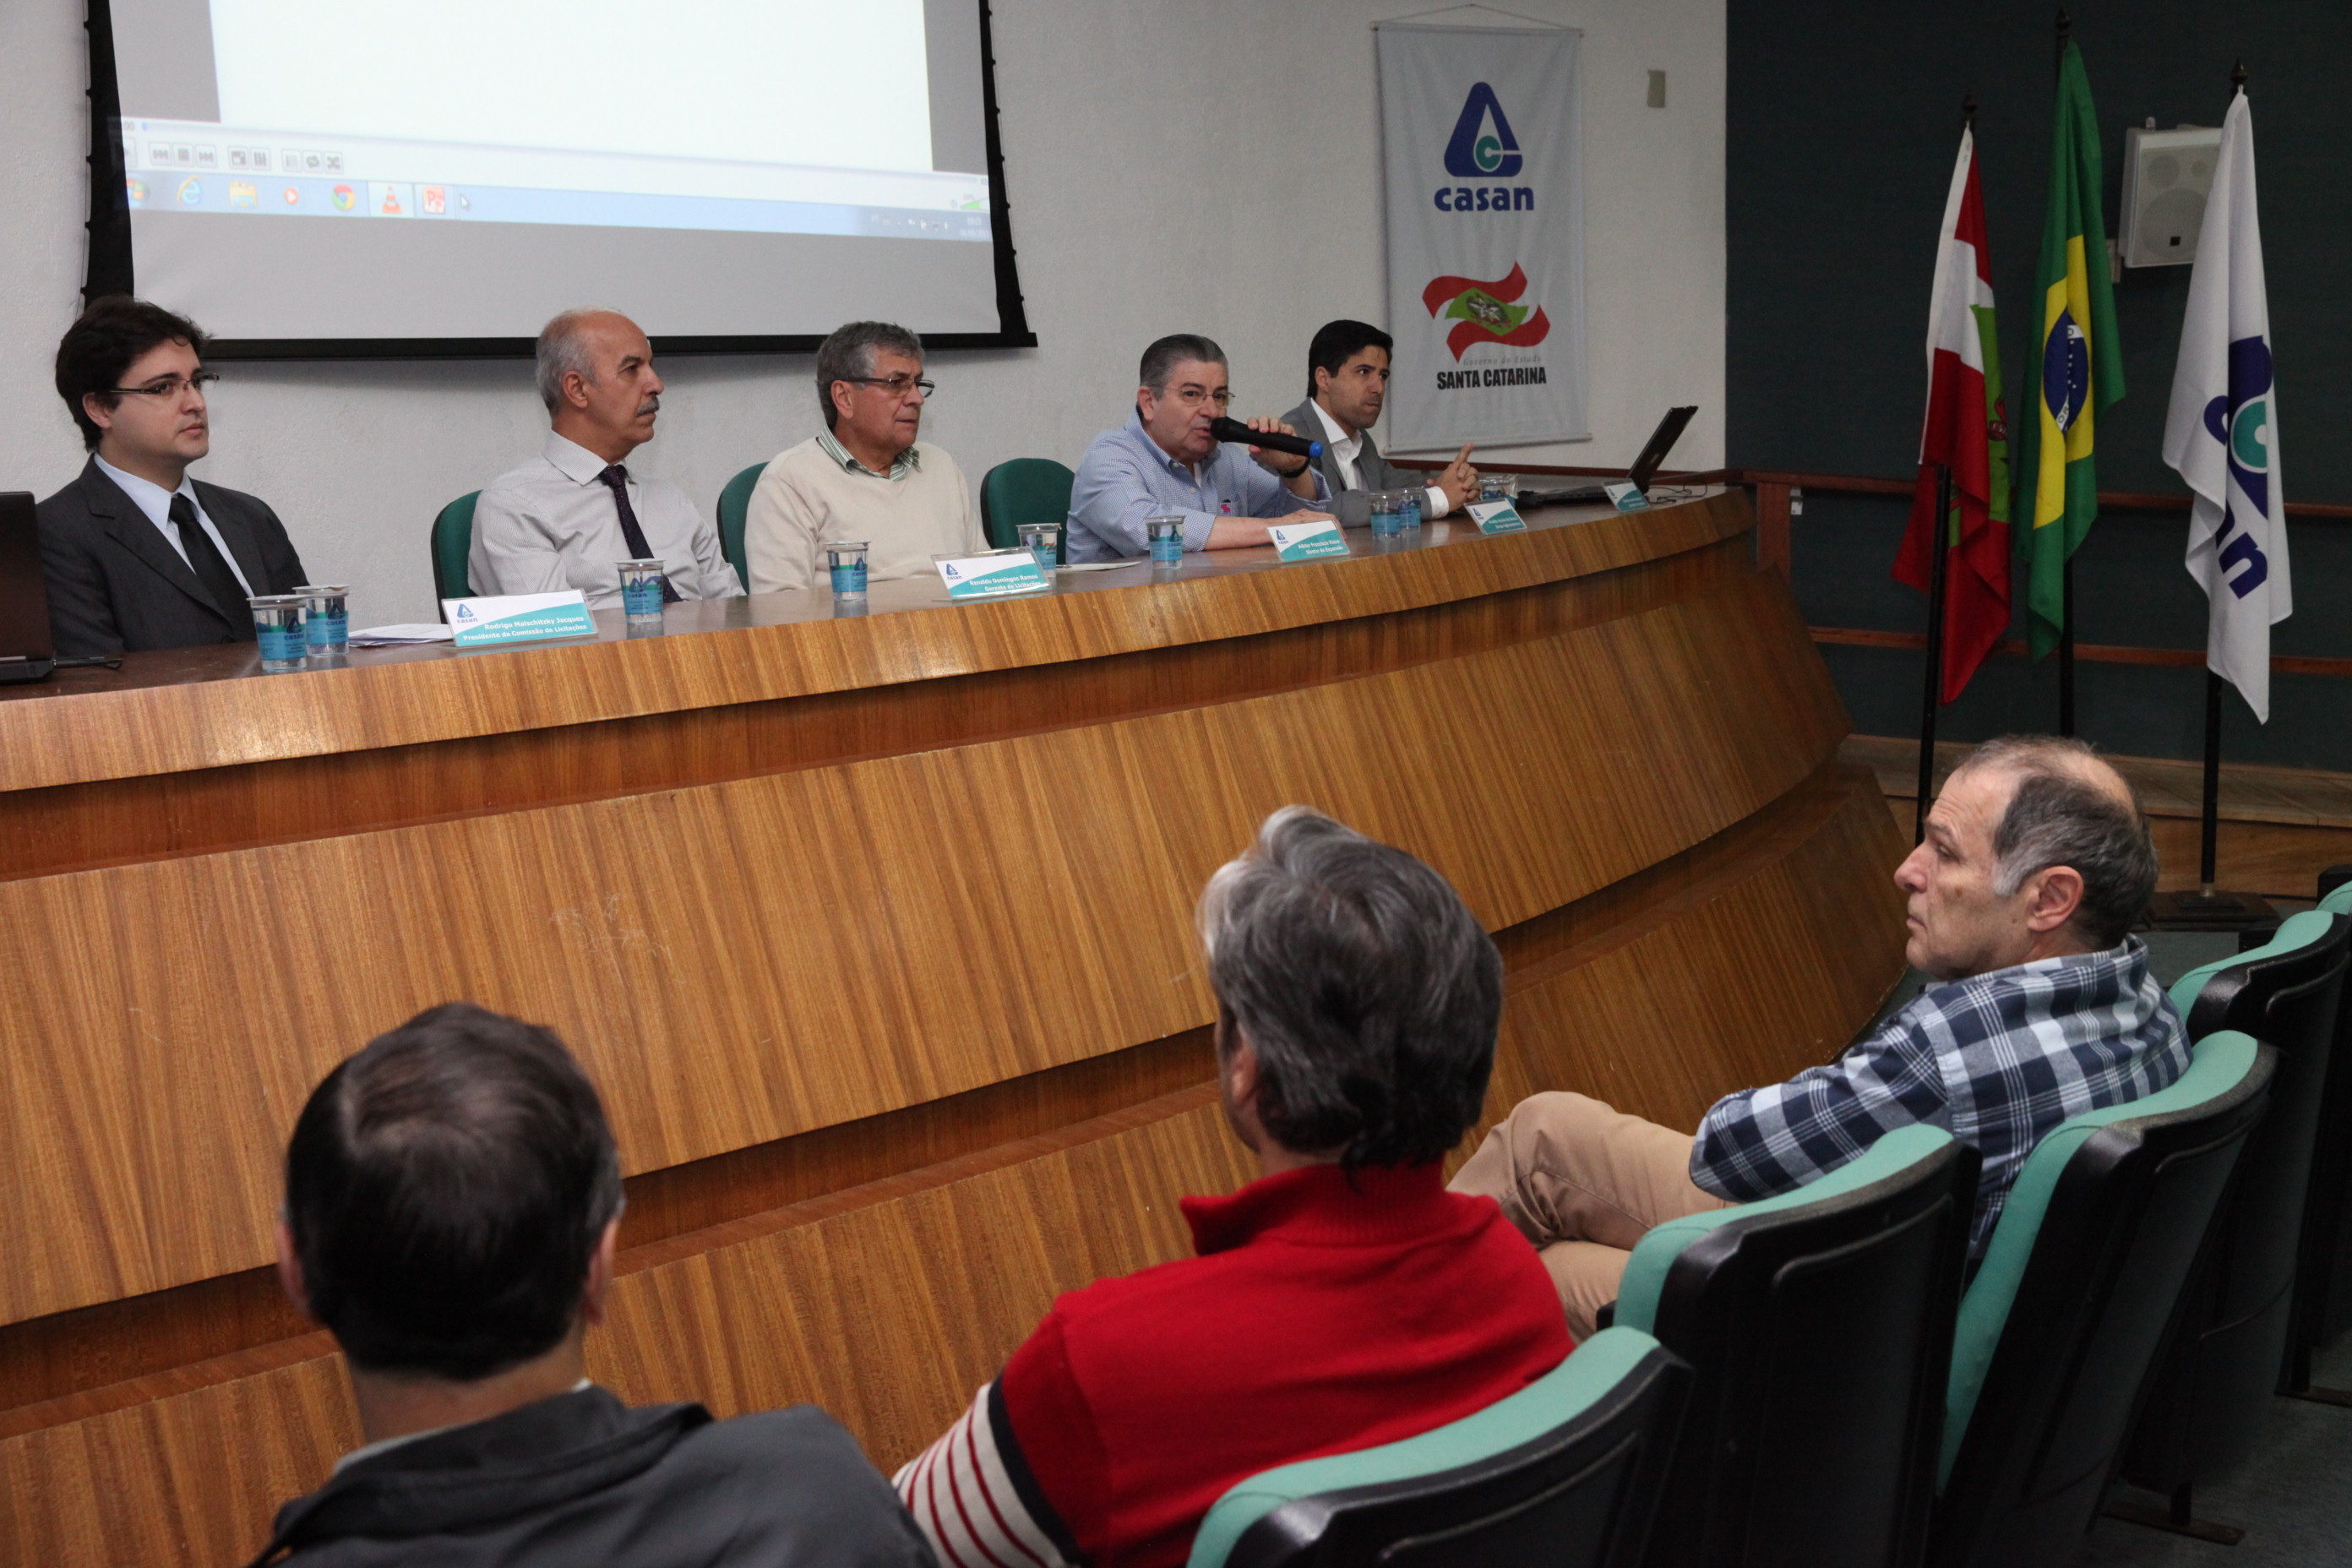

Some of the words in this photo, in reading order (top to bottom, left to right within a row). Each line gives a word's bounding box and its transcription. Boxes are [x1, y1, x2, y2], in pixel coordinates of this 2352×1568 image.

[1434, 187, 1535, 212] casan
[1463, 357, 1498, 366] Governo
[1515, 355, 1542, 364] Estado
[1437, 370, 1481, 390] SANTA
[1483, 367, 1547, 387] CATARINA
[484, 622, 513, 630] Rodrigo
[514, 618, 555, 628] Malschitzky
[556, 615, 585, 623] Jacques
[463, 632, 500, 640] Presidente
[511, 628, 543, 636] Comissão
[554, 623, 587, 632] Licitações
